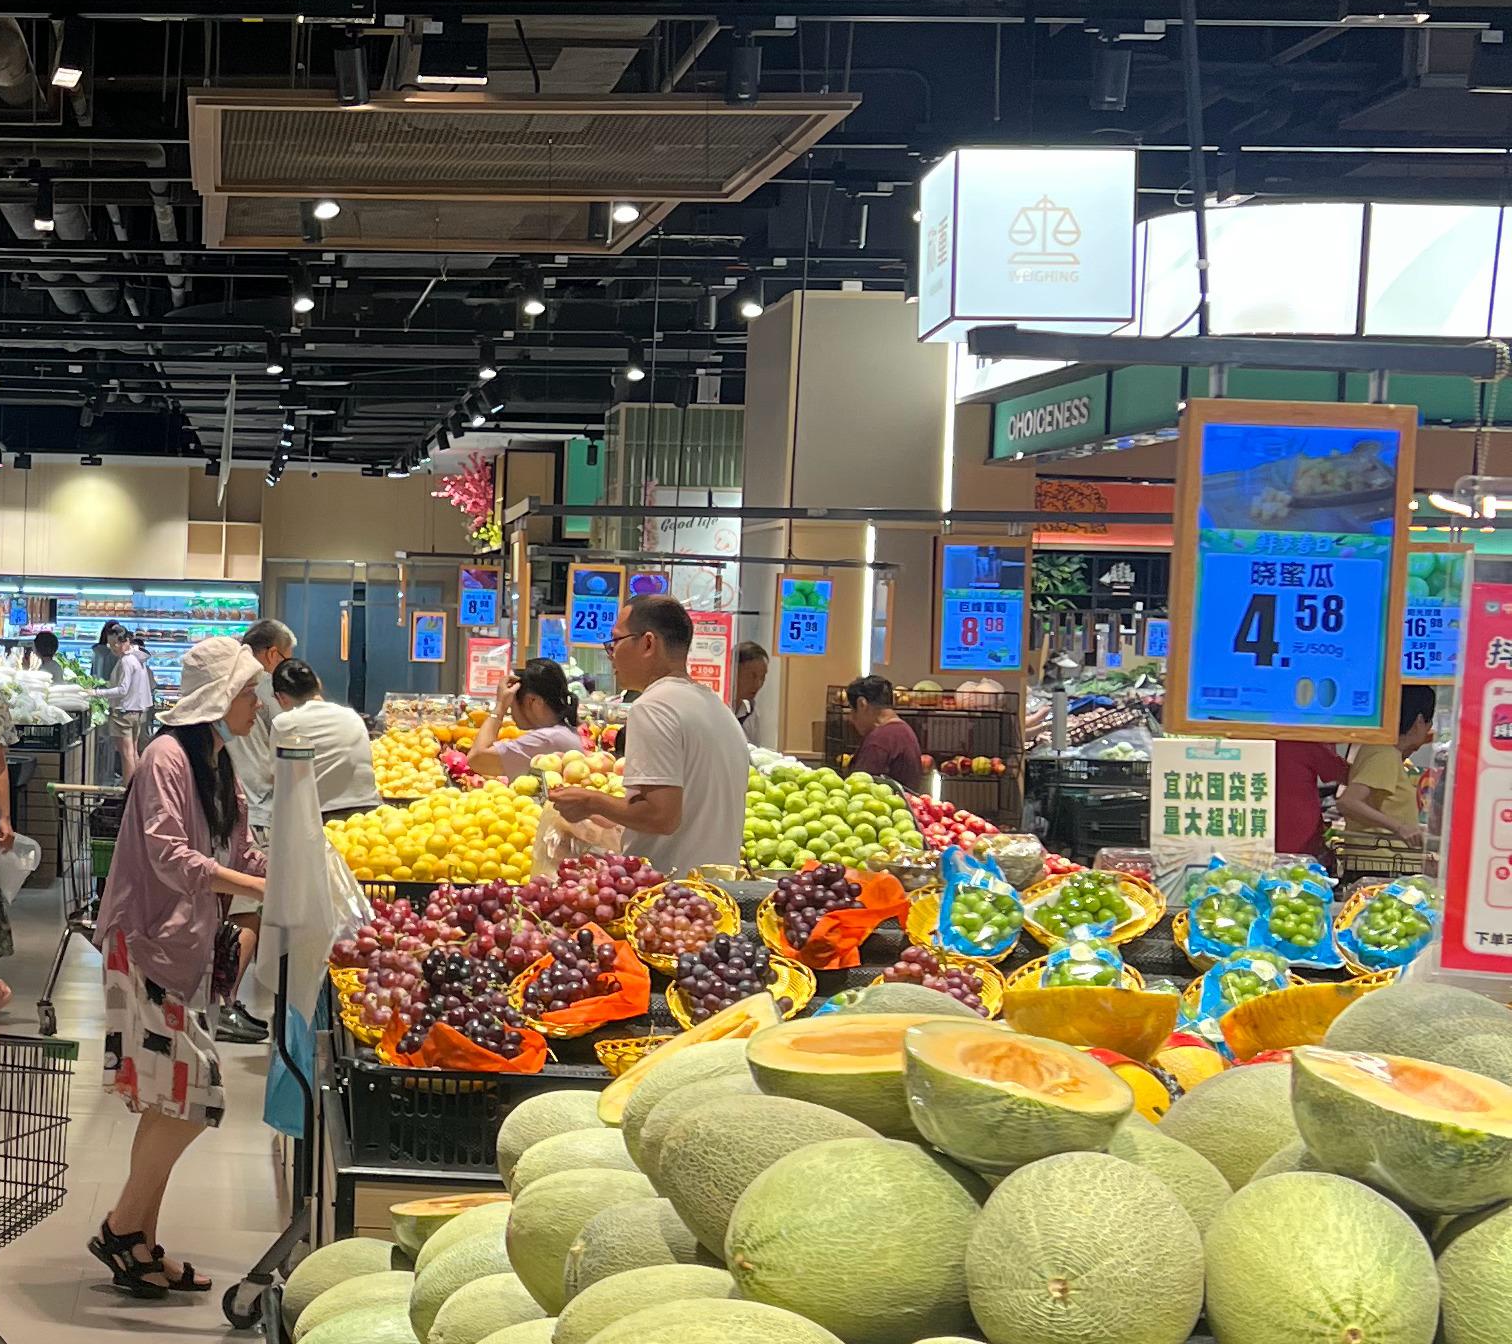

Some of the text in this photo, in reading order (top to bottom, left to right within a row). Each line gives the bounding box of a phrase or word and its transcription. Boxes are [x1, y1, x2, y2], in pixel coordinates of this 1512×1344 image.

[1008, 396, 1090, 441] CHOICENESS
[1251, 561, 1334, 588] 晓蜜瓜
[1163, 806, 1267, 838] 量大超划算
